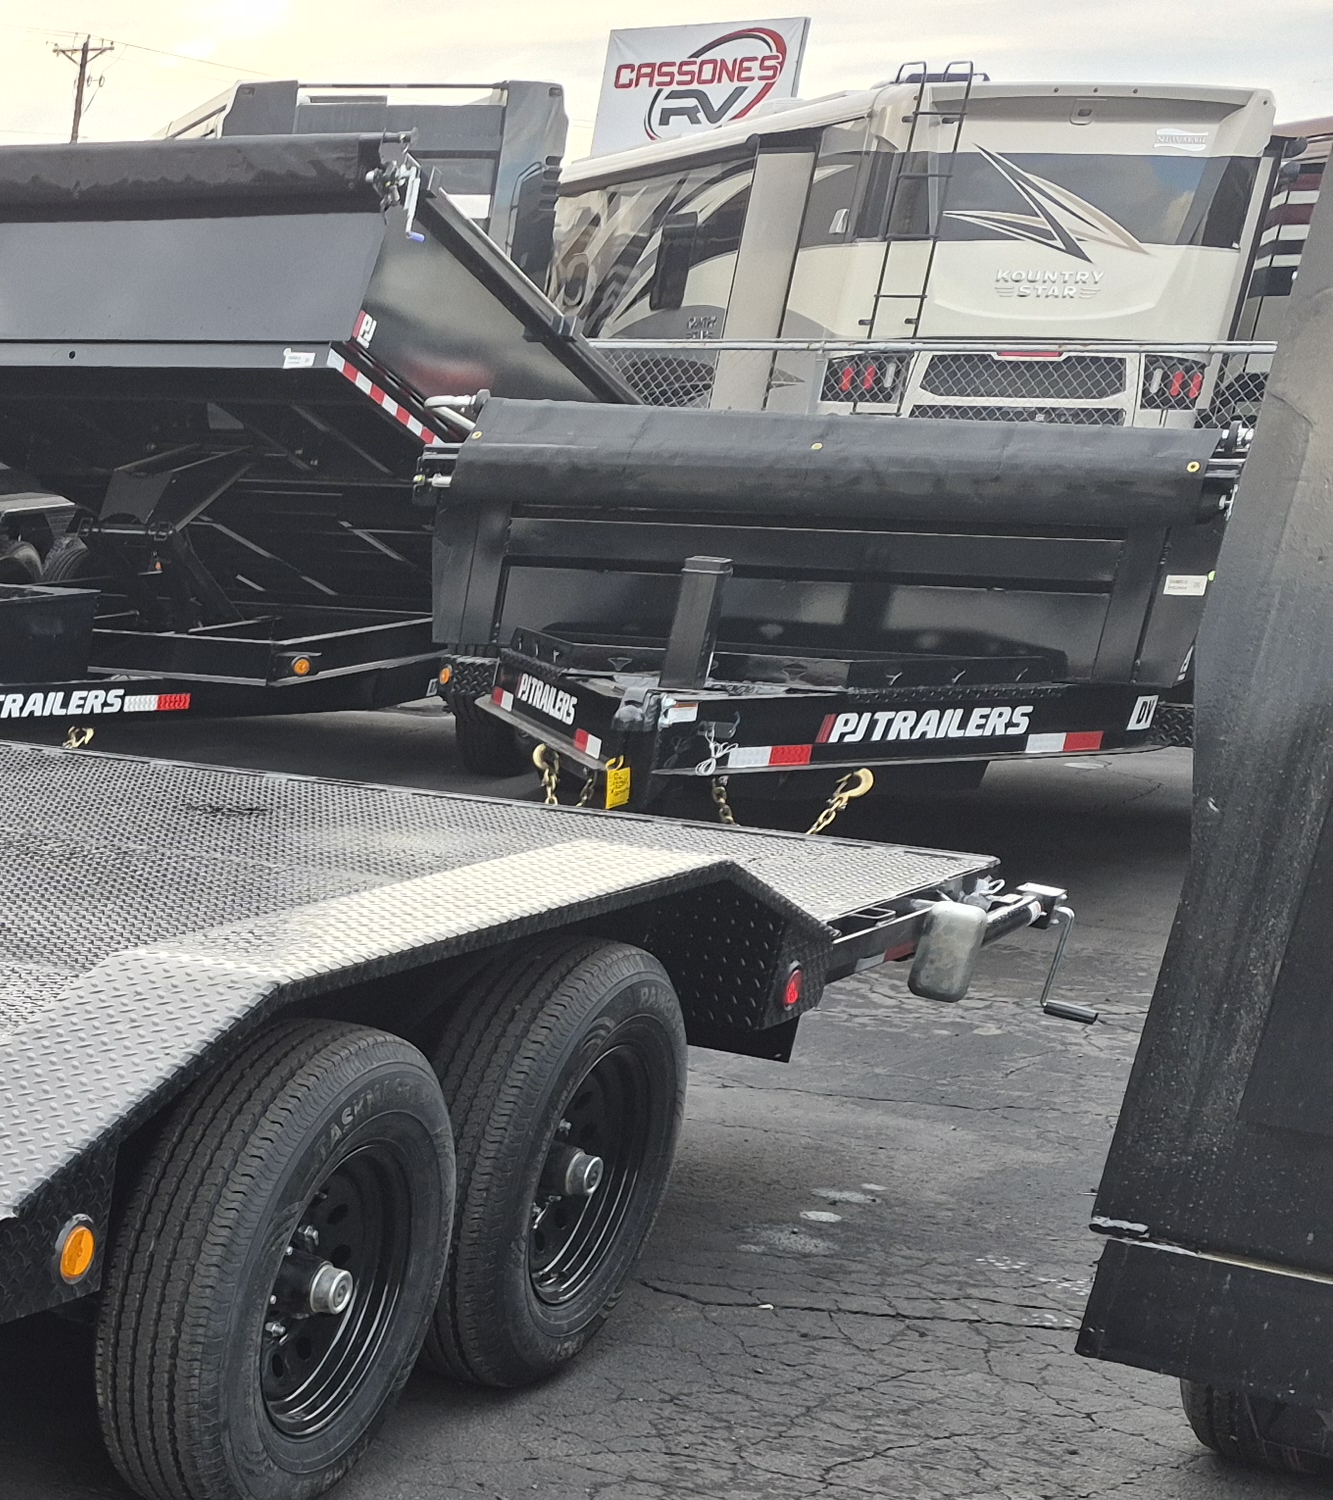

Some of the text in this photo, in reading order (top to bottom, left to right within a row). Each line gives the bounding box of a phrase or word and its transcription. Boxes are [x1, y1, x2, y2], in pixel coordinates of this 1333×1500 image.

[614, 54, 782, 89] CASSONES
[658, 86, 749, 126] RV
[995, 269, 1104, 284] KOUNTRY
[1017, 285, 1077, 299] STAR
[528, 678, 578, 725] TRAILERS
[827, 706, 1034, 744] PJ TRAILERS
